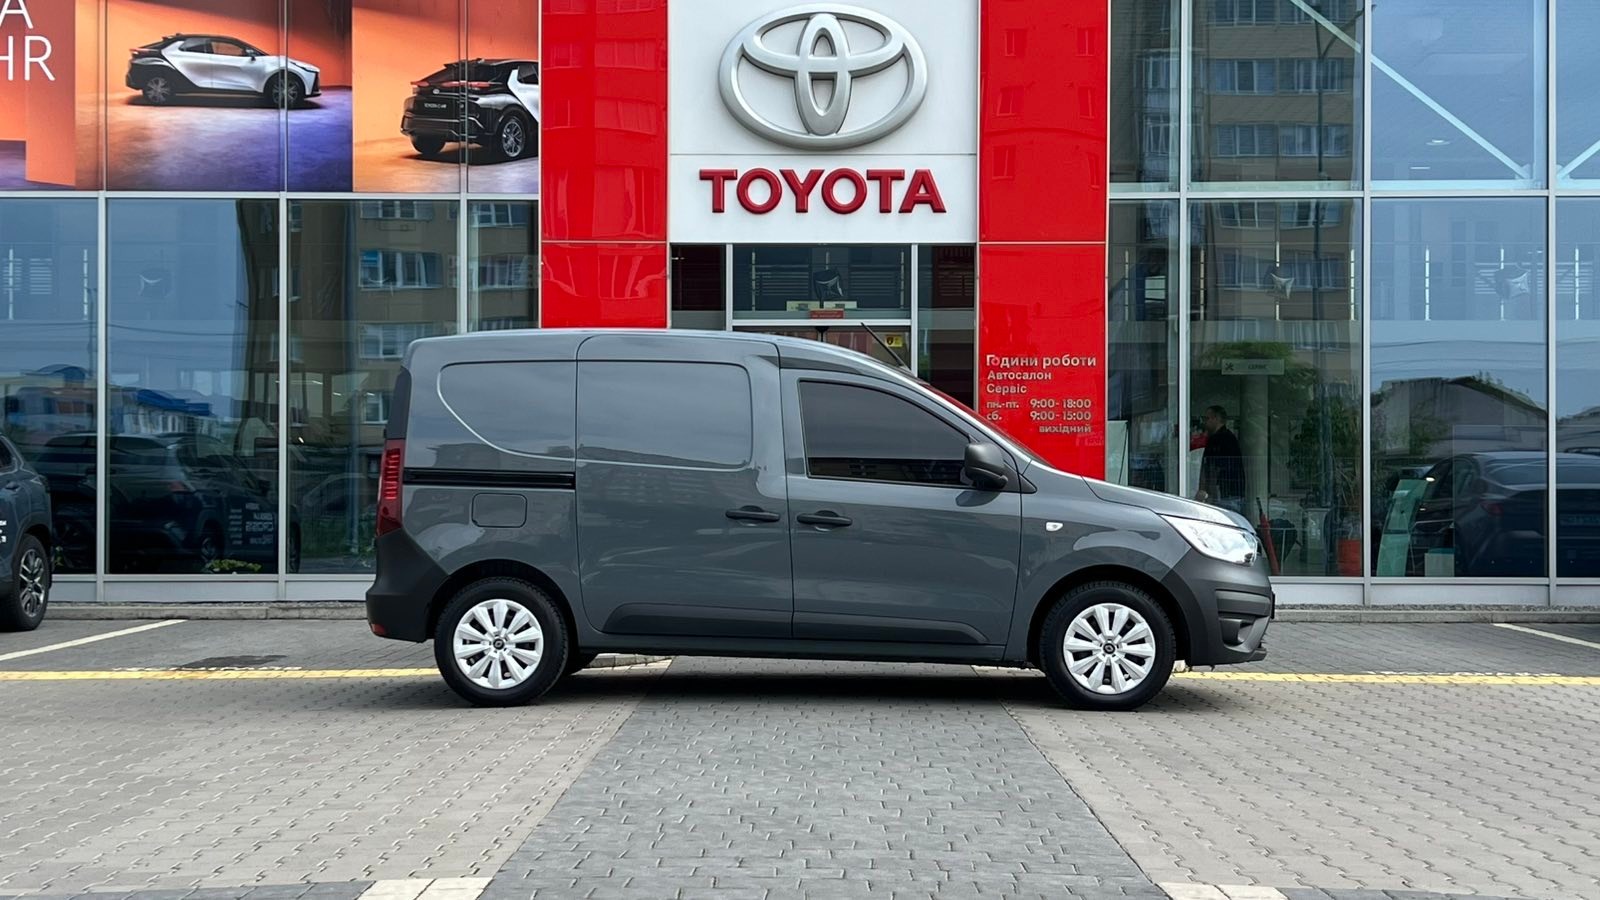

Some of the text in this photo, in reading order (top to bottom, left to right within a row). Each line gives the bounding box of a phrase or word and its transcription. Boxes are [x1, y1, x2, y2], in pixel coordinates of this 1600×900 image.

[699, 168, 947, 214] TOYOTA
[986, 354, 1096, 369] Години роботи
[987, 370, 1052, 380] Автосалон
[986, 383, 1027, 395] Сервіс
[1063, 398, 1091, 408] 18:00
[986, 410, 1003, 420] сб.
[1063, 411, 1091, 420] 15:00
[1039, 423, 1092, 434] вихідний
